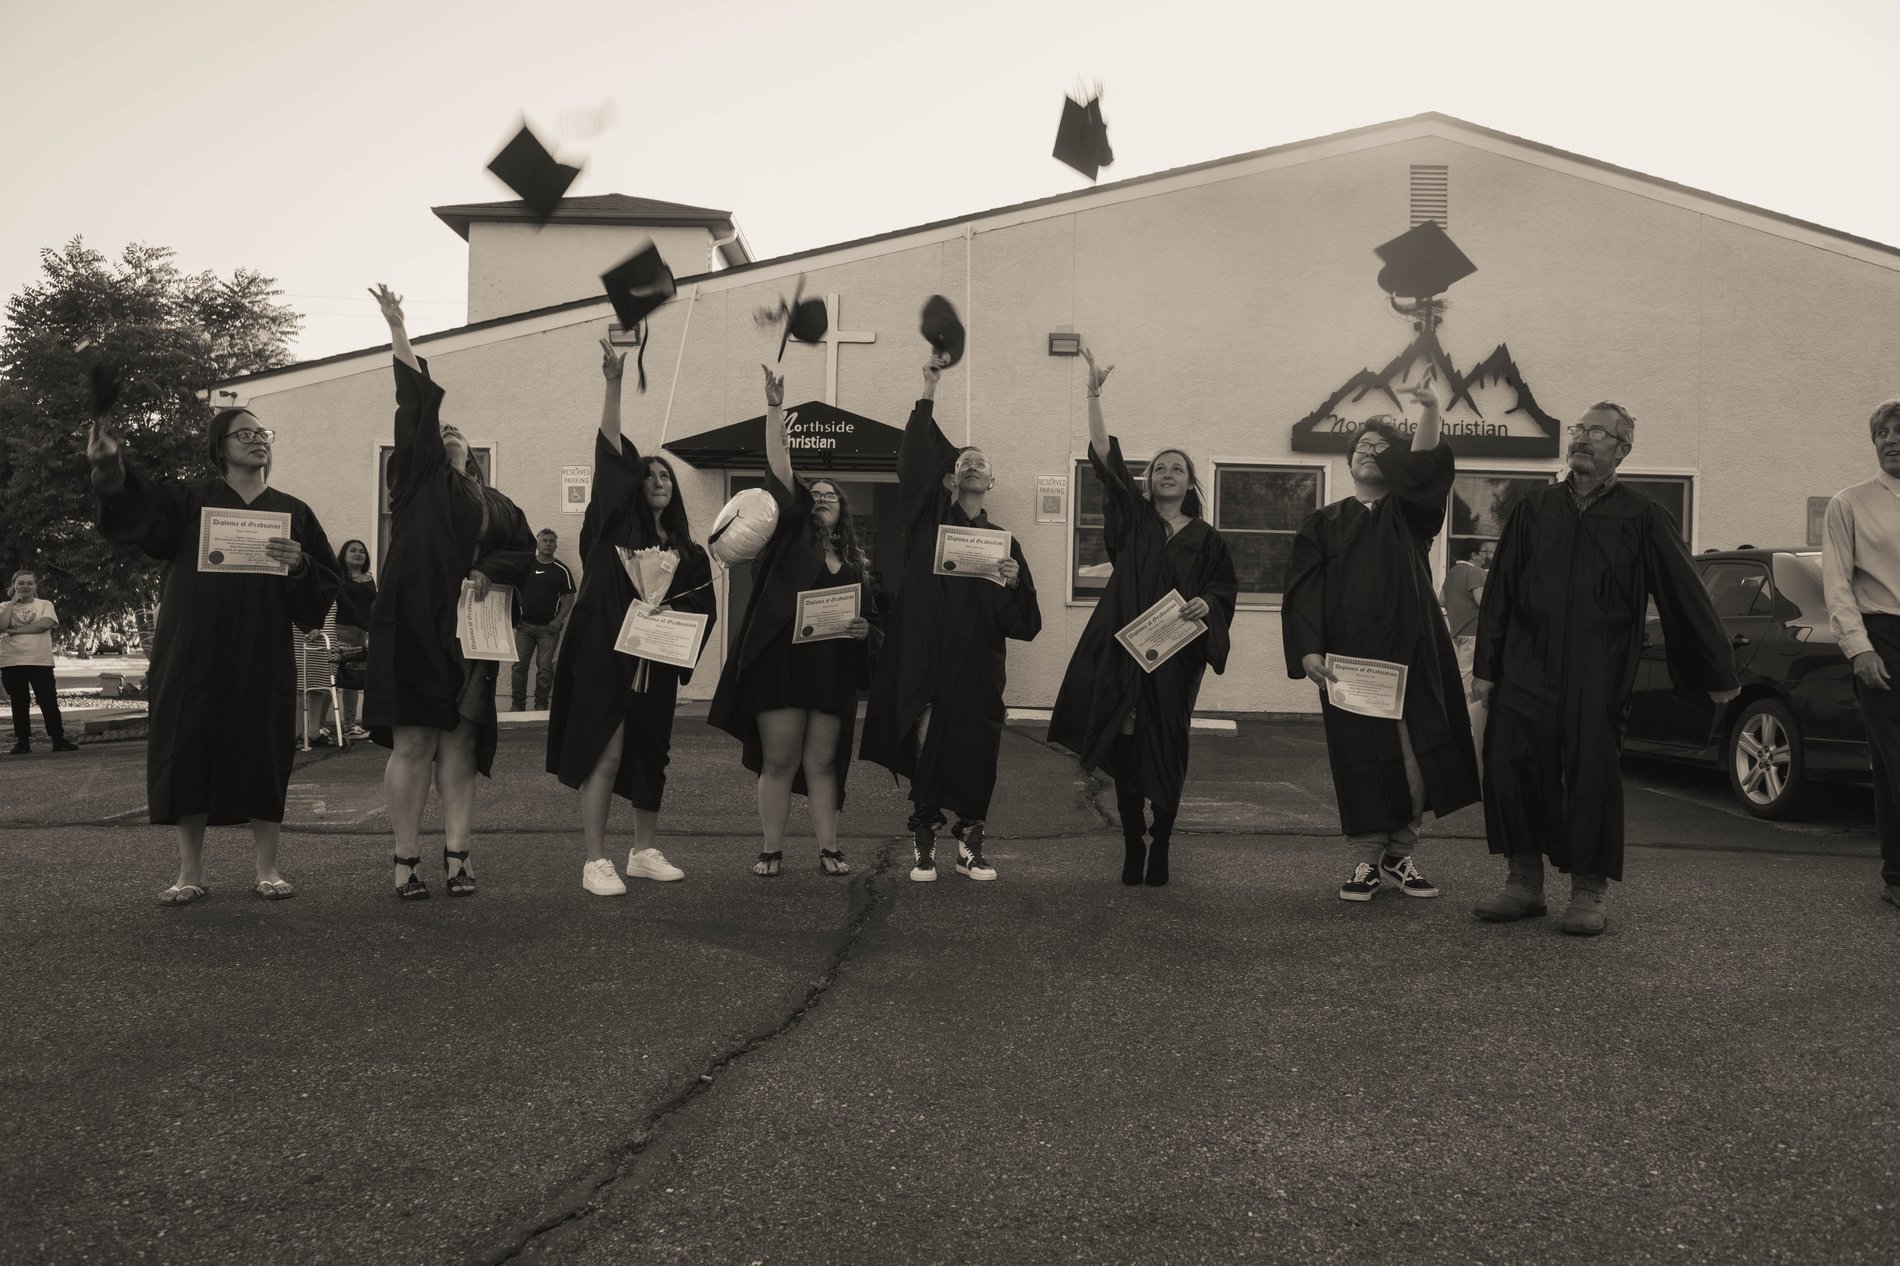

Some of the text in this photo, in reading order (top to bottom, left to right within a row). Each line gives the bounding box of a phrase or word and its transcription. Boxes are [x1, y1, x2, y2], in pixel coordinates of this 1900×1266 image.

[783, 410, 854, 434] Northside
[1440, 416, 1508, 436] hristian
[787, 435, 836, 449] hristian
[562, 468, 591, 476] RESERVED
[1038, 479, 1067, 487] RESERVED
[1039, 487, 1065, 495] PARKING
[212, 519, 239, 527] Diploma
[1335, 663, 1359, 671] Diploma
